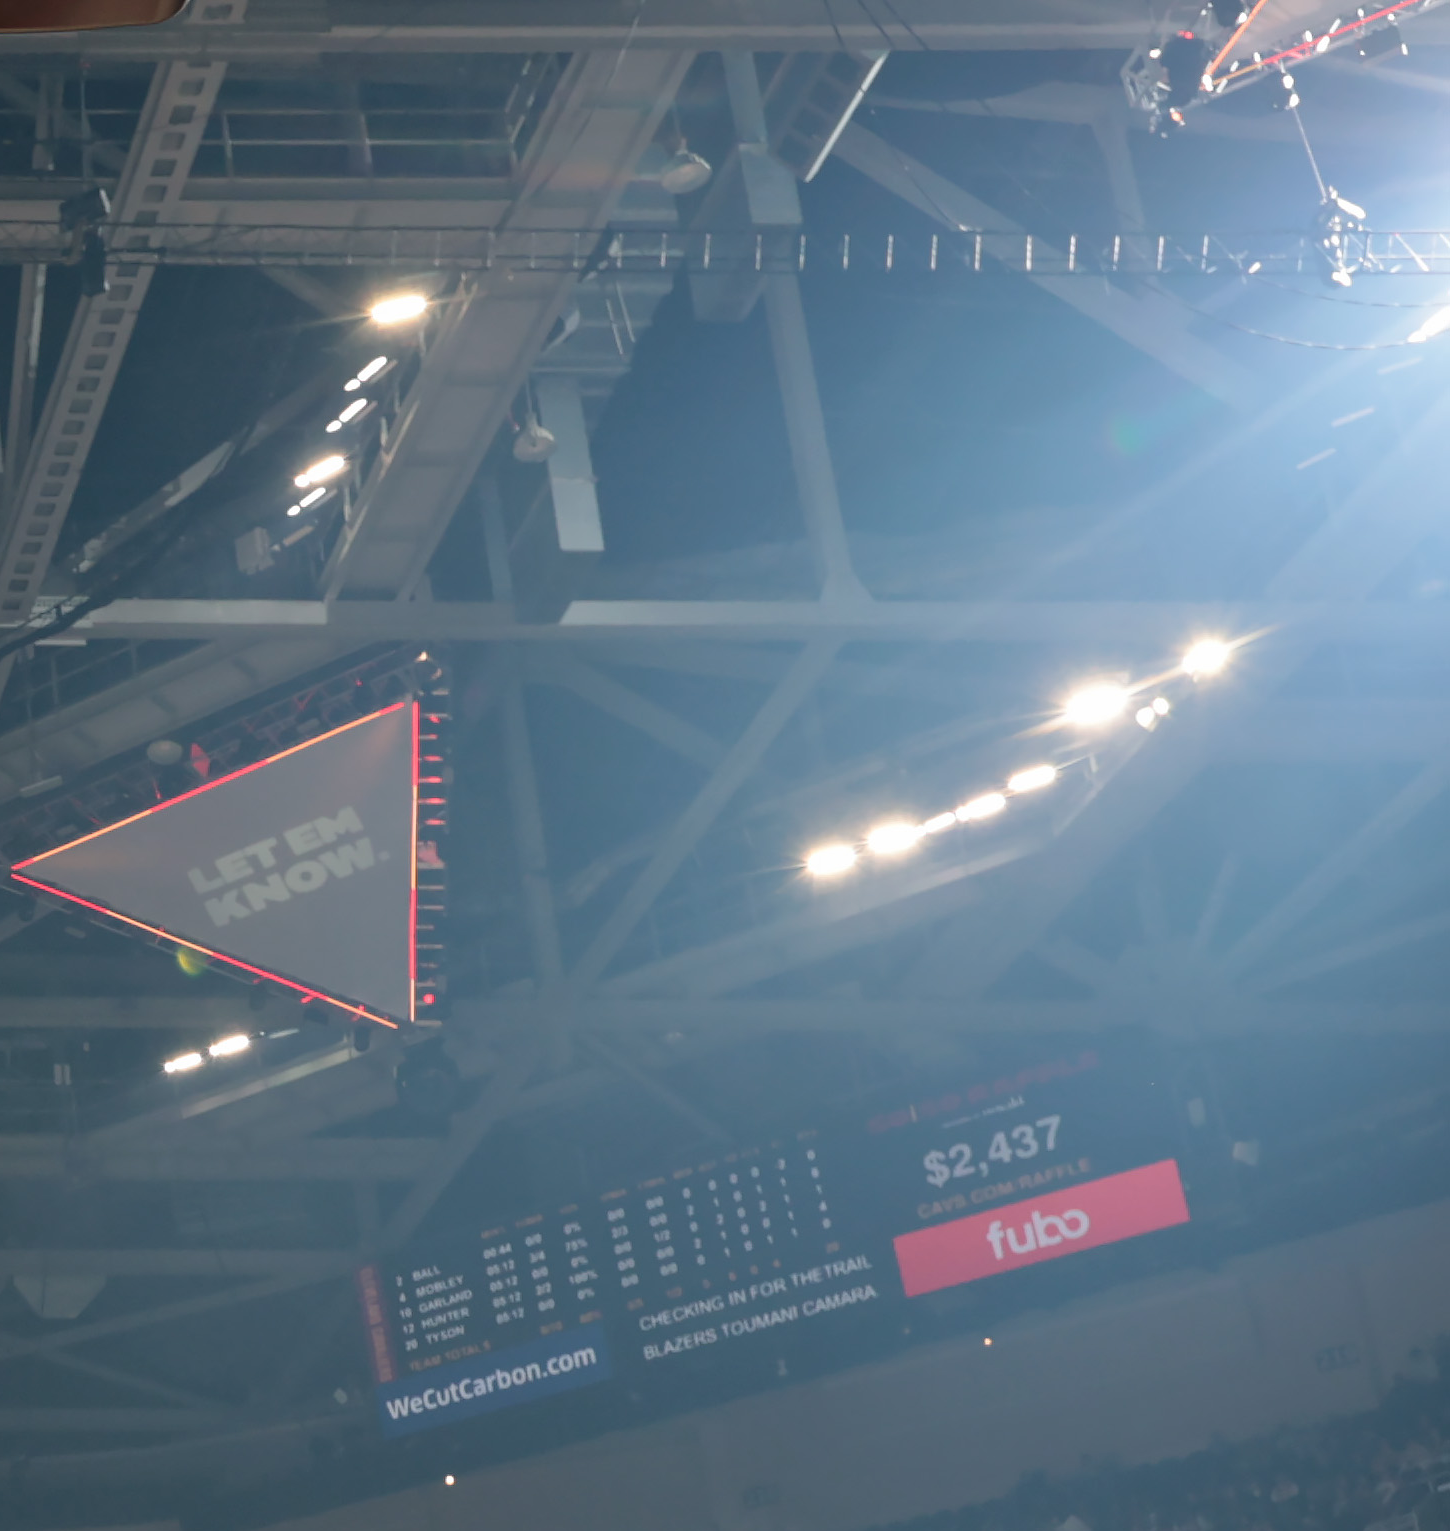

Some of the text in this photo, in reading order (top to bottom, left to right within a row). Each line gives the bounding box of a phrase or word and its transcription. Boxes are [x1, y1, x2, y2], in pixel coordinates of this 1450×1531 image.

[187, 805, 364, 895] LET EM
[923, 1114, 1062, 1189] $2,437
[985, 1207, 1092, 1261] fubo
[421, 1307, 470, 1330] HUNTER
[639, 1295, 725, 1331] CHECKING
[728, 1288, 748, 1307] IN
[749, 1277, 787, 1300] FOR
[789, 1266, 824, 1288] THE
[825, 1254, 873, 1279] TRAIL
[643, 1284, 879, 1361] BLAZERS TOUMANI CAMARA
[387, 1343, 598, 1421] WeCutCarbon.com
